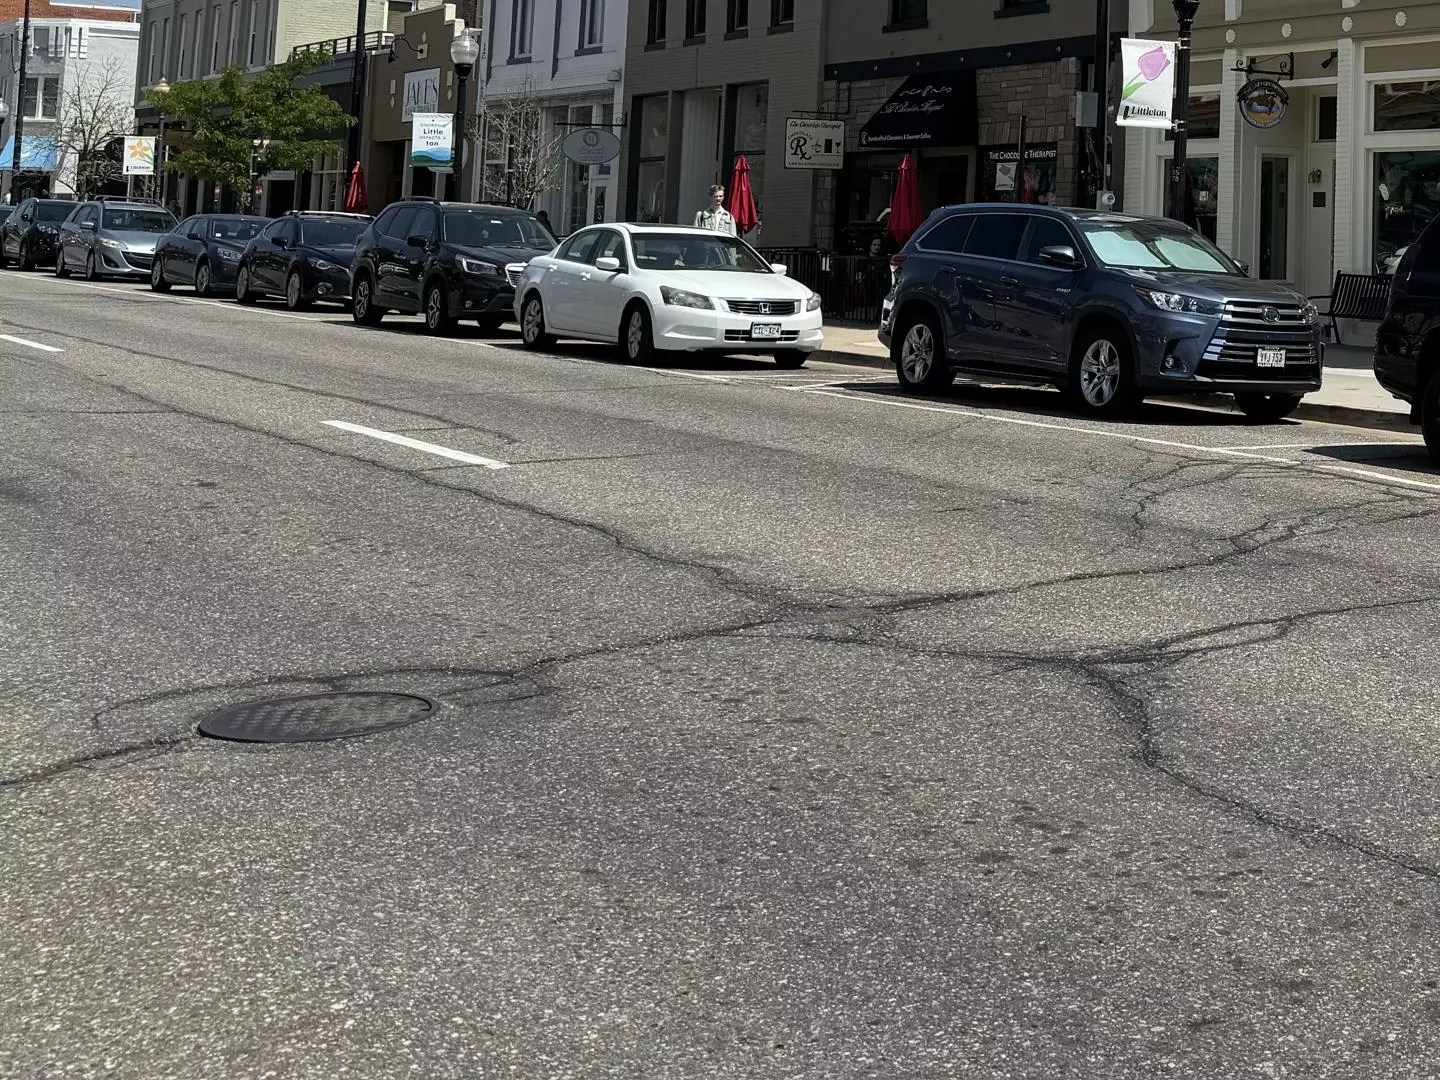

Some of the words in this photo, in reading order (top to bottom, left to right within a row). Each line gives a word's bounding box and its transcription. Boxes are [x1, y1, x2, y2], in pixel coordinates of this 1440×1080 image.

[1131, 106, 1167, 118] Littleton
[989, 151, 999, 160] THE
[1030, 149, 1056, 158] THERAPIST
